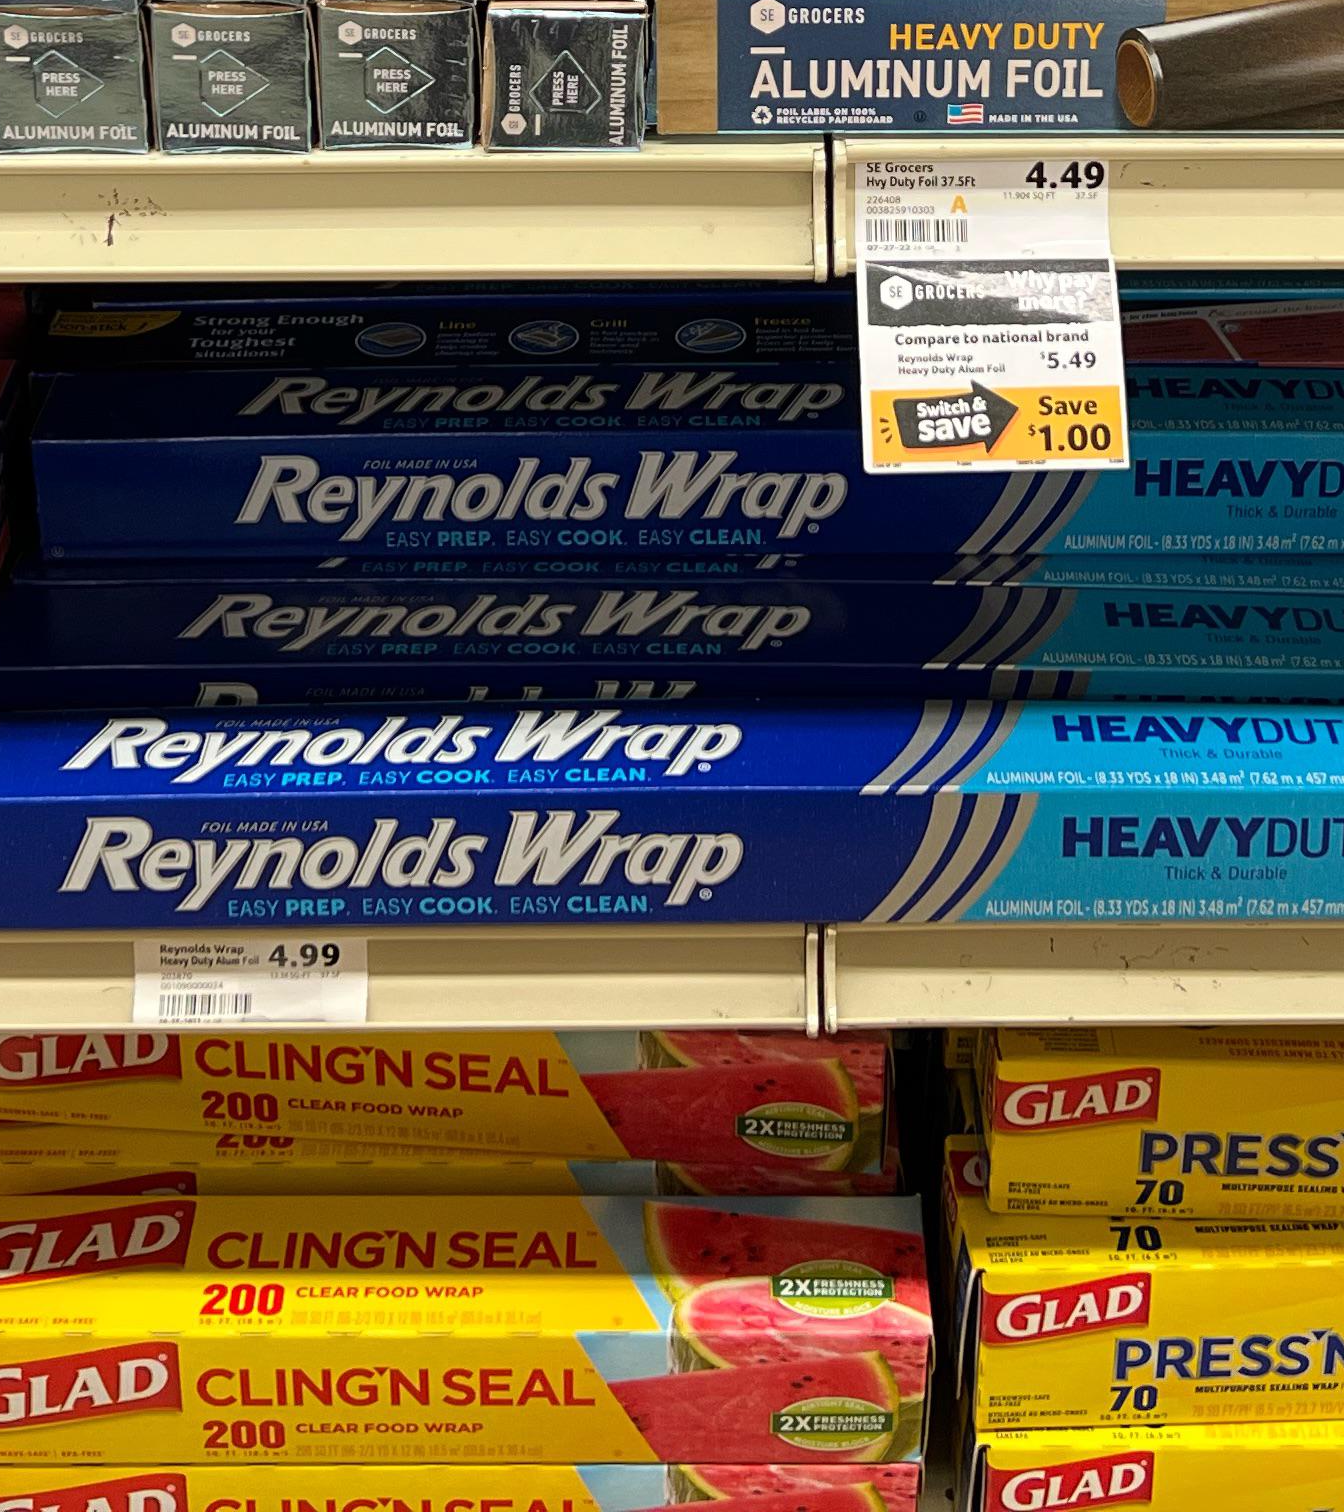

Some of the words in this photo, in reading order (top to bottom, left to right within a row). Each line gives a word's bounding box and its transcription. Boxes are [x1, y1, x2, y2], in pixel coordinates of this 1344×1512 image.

[759, 7, 775, 23] SE
[787, 7, 866, 25] GROCERS
[889, 22, 1004, 51] HEAVY
[1013, 22, 1105, 50] DUTY
[750, 59, 992, 99] ALUMINUM
[1006, 58, 1104, 98] FOIL
[866, 162, 882, 173] SE
[884, 161, 934, 173] Grocers
[1025, 161, 1105, 190] 4.49
[866, 176, 887, 190] Hvy
[889, 176, 917, 190] Duty
[918, 175, 939, 187] Foil
[895, 332, 960, 349] Compare
[963, 333, 979, 345] to
[982, 331, 1043, 344] national
[1046, 330, 1089, 343] brand
[1040, 351, 1097, 370] $5.49
[916, 397, 970, 418] Switch
[972, 395, 988, 413] &
[1038, 395, 1098, 417] Save
[918, 413, 992, 443] save
[1027, 422, 1112, 453] $1.00
[58, 816, 488, 913] Reynolds
[493, 810, 744, 906] Wrap
[1164, 865, 1206, 881] Thick
[1209, 867, 1223, 881] &
[1227, 865, 1288, 882] Durable
[227, 898, 280, 918] EASY
[361, 897, 414, 917] EASY
[509, 896, 562, 916] EASY
[268, 942, 341, 968] 4.99
[1001, 1076, 1154, 1127] GLAD
[1134, 1179, 1185, 1206] 70
[447, 1231, 598, 1270] SEAL
[296, 1287, 358, 1299] CLEAR
[364, 1287, 418, 1299] FOOD
[423, 1286, 484, 1299] WRAP
[779, 1278, 812, 1297] 2X
[813, 1279, 886, 1289] FRESHNESS
[813, 1288, 883, 1297] PROTECTION
[199, 1283, 286, 1316] 200
